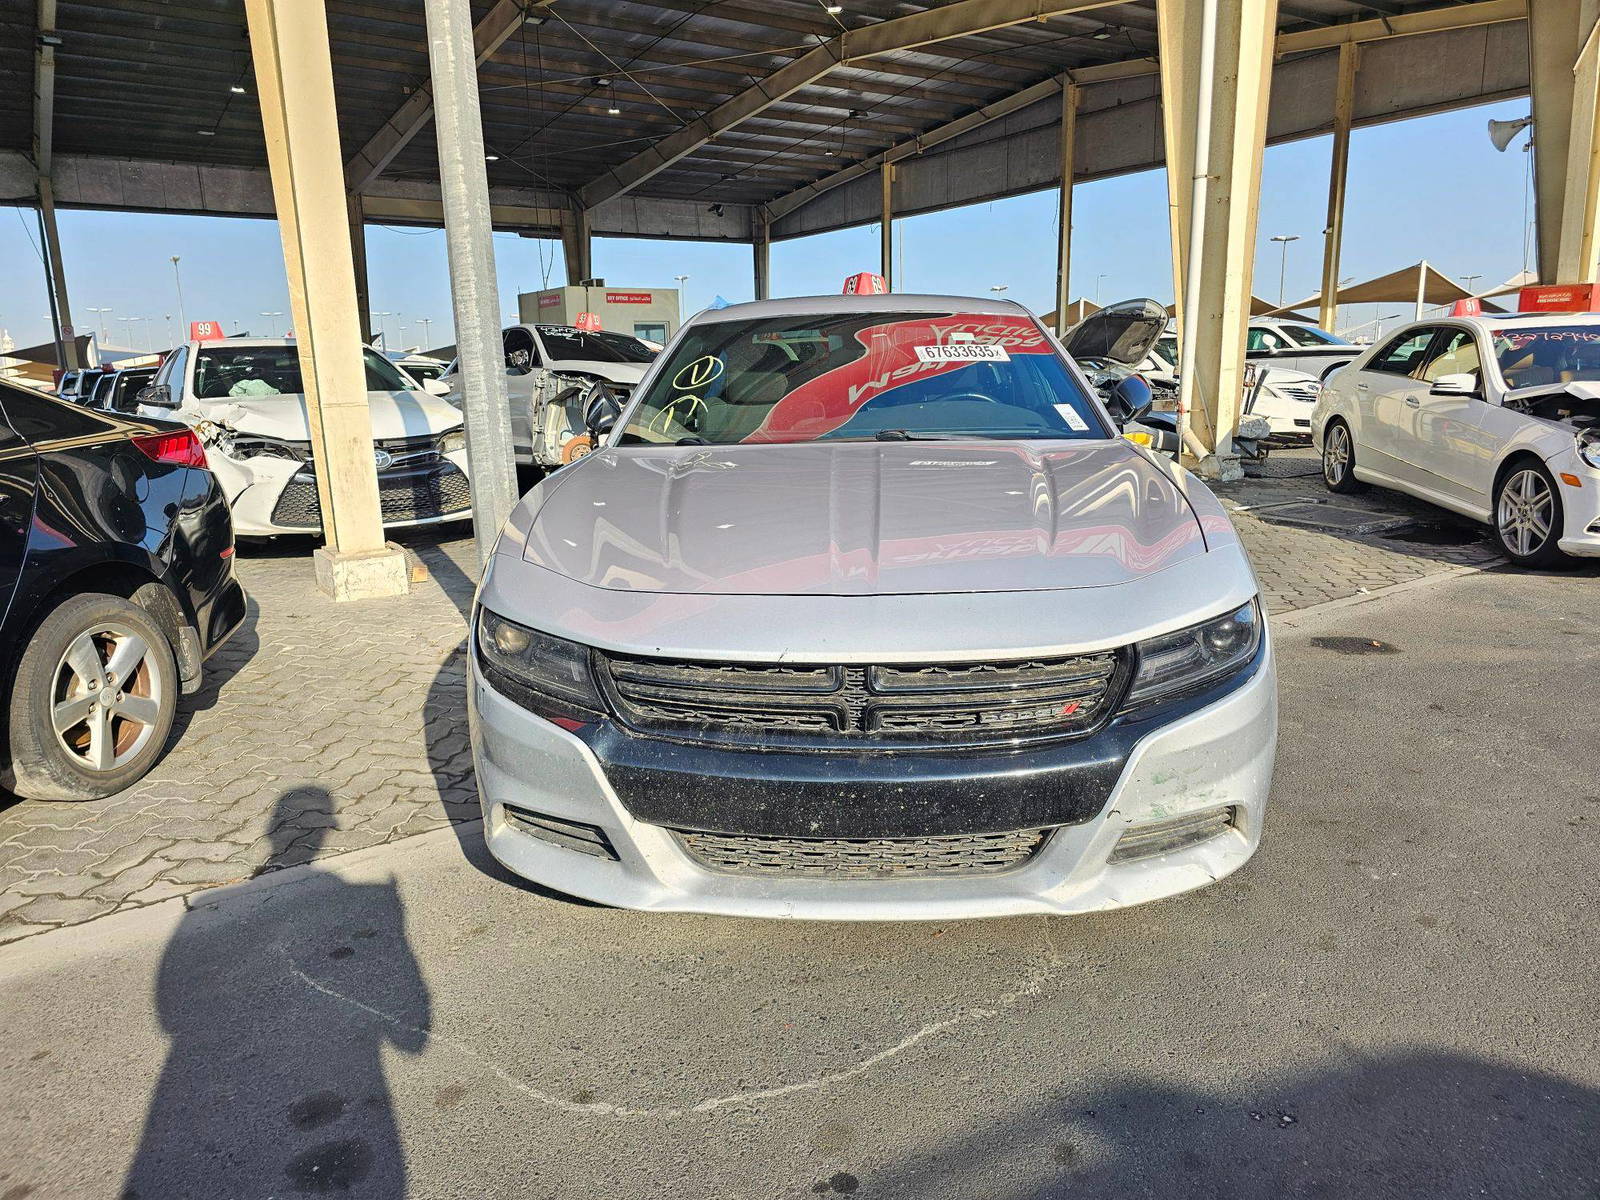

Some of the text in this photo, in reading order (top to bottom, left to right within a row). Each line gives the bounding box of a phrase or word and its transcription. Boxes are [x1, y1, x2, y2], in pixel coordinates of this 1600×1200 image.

[1465, 300, 1476, 313] 81
[198, 323, 211, 336] 99
[924, 345, 995, 359] 67633635
